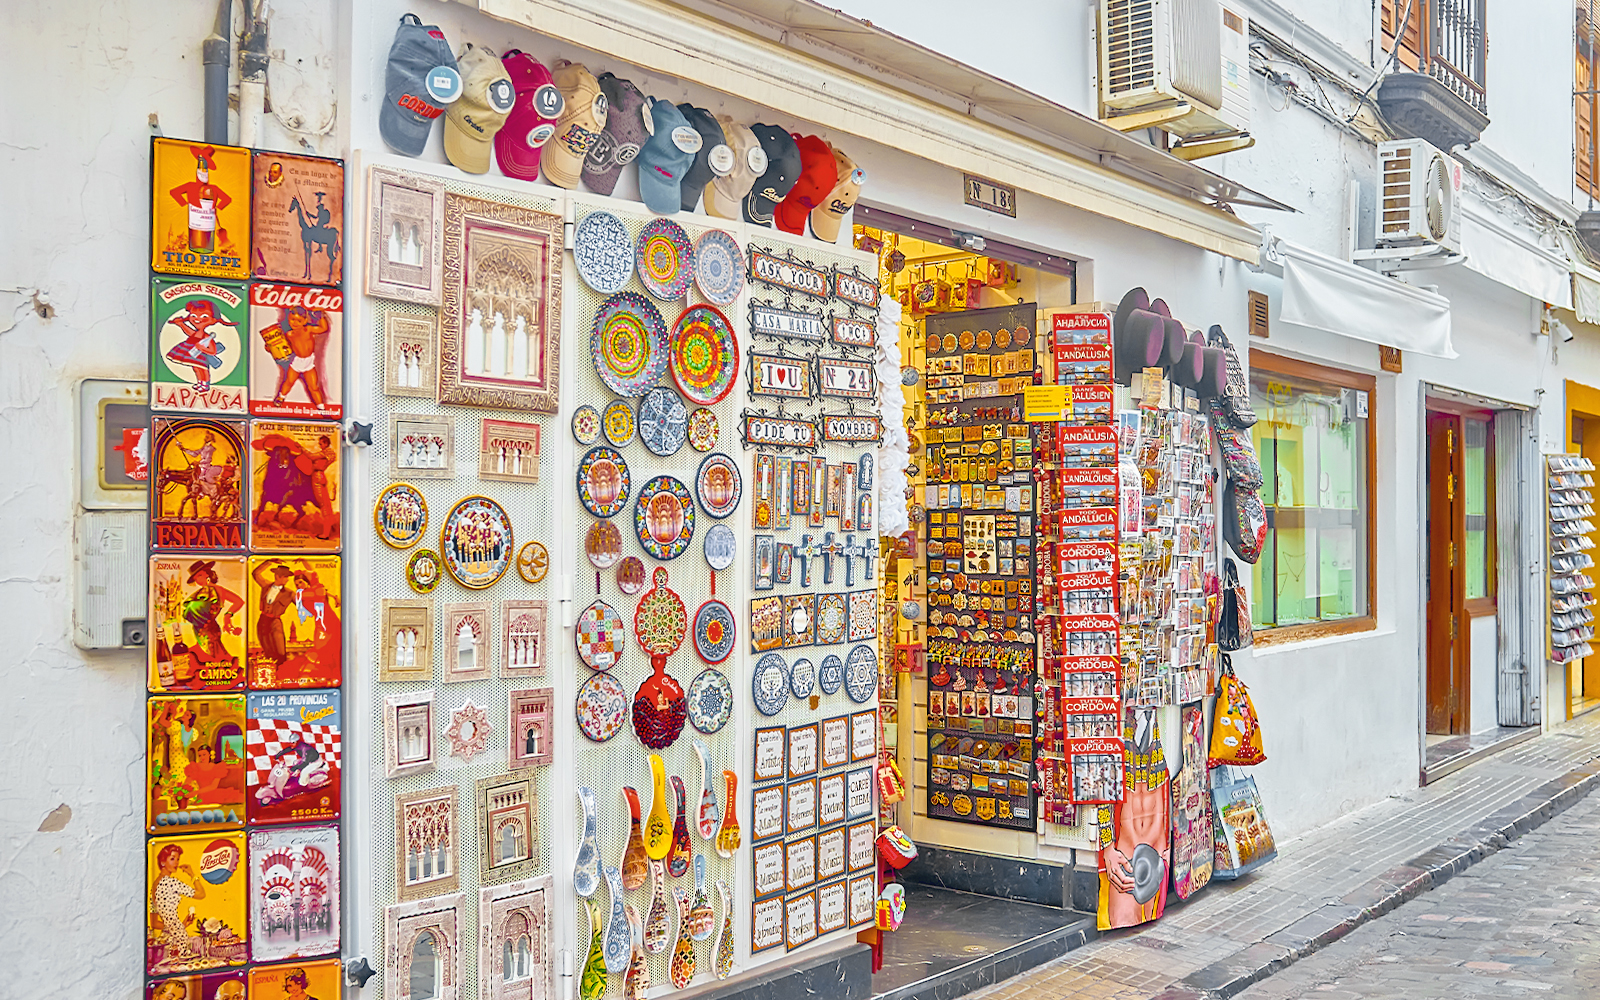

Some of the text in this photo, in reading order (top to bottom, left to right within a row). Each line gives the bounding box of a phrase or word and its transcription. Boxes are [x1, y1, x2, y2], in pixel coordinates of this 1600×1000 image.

[992, 188, 1006, 207] 18
[162, 251, 241, 268] TIO PEPE
[760, 259, 820, 289] ASK YOUR
[164, 284, 237, 305] GASEOSA SELECTA
[754, 312, 821, 335] CASA MARIA
[1056, 319, 1107, 328] АНДАЛУСИЯ
[1057, 351, 1110, 360] L'ANDALUSIA
[788, 367, 798, 388] U
[848, 369, 867, 389] 24
[1072, 391, 1110, 400] DALUSIEN
[263, 406, 293, 414] alimento
[259, 423, 275, 431] PLAZA
[755, 424, 807, 440] PIDE TU
[832, 422, 872, 435] NOMBRE
[1063, 432, 1115, 441] ANDALUSIA
[1063, 474, 1115, 483] L'ANDALOUSIE
[1062, 512, 1114, 524] ANDALUCÍA
[156, 524, 242, 548] ESPAÑA
[157, 562, 181, 570] ESPAÑA
[1061, 576, 1112, 588] CORDOUE
[1065, 619, 1116, 629] CORDOBA
[1064, 661, 1115, 670] CORDOBA
[199, 669, 238, 680] CAMPOS
[262, 694, 328, 706] LAS 20 PROVINCIAS
[1065, 702, 1117, 712] CORDOVA
[1070, 743, 1121, 752] КОРДОВА
[850, 781, 869, 792] CARPE
[850, 793, 869, 807] DIEM
[291, 808, 319, 816] 2500
[156, 809, 239, 827] CORDOBA
[254, 974, 278, 985] ESPAÑA
